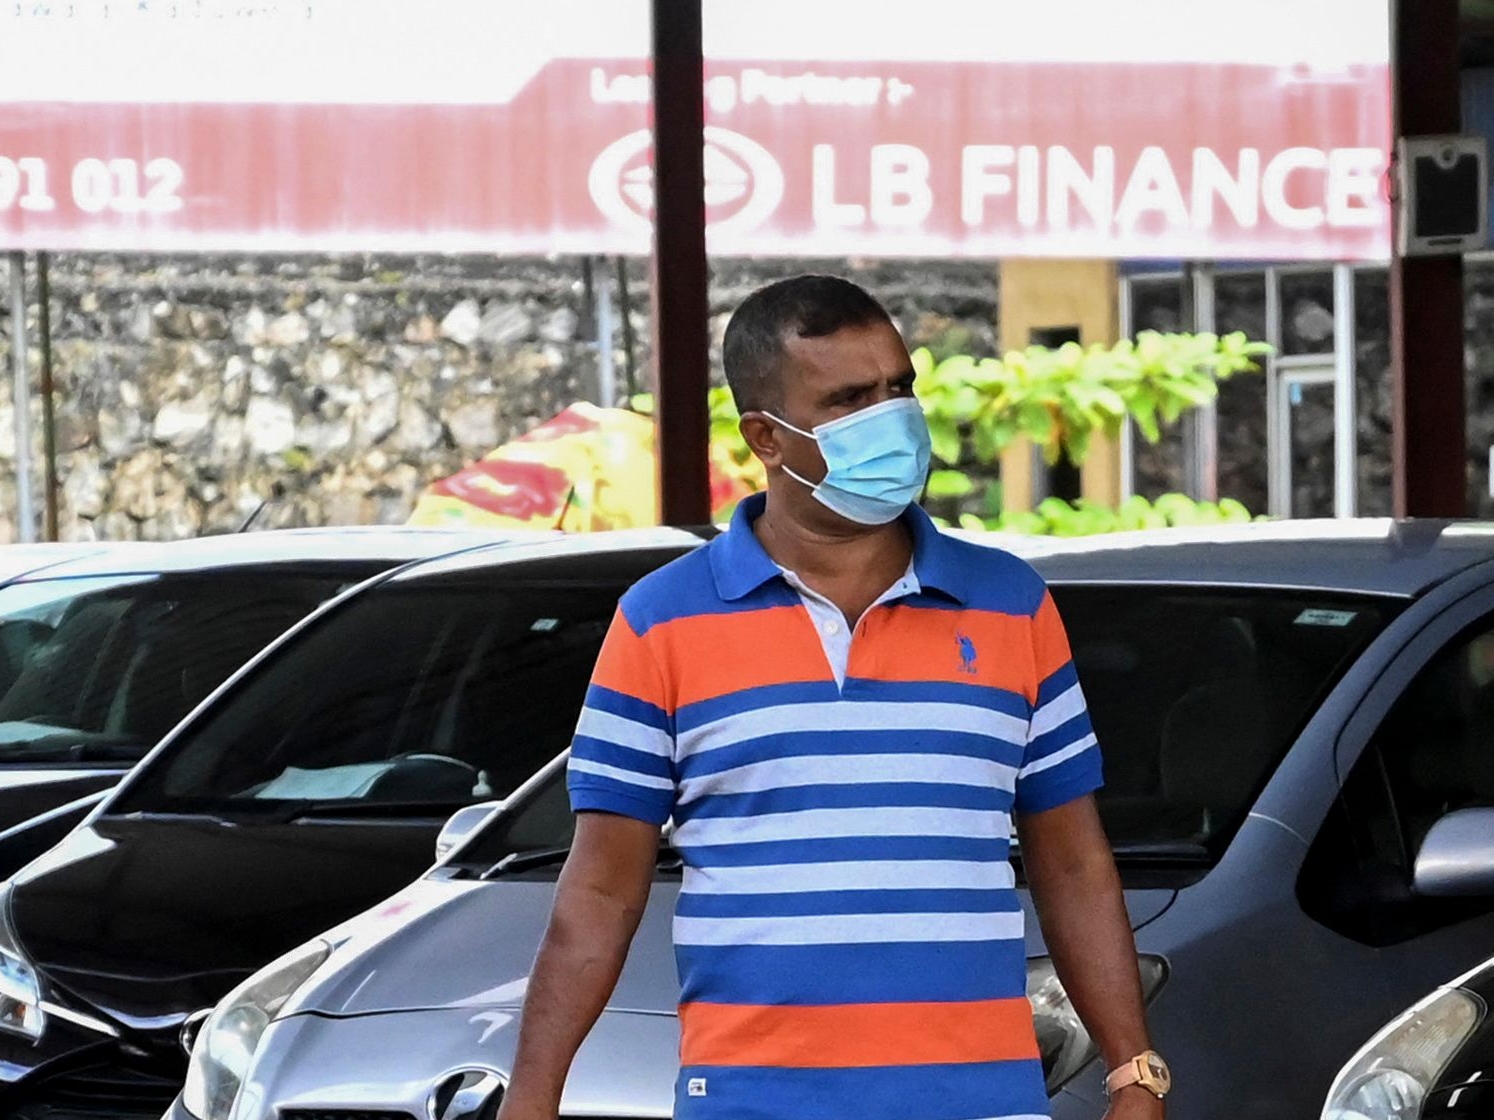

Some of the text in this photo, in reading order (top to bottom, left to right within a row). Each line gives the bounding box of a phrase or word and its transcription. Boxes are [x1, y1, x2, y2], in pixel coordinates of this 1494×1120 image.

[71, 157, 184, 213] 012
[813, 144, 1384, 228] LB FINANCE
